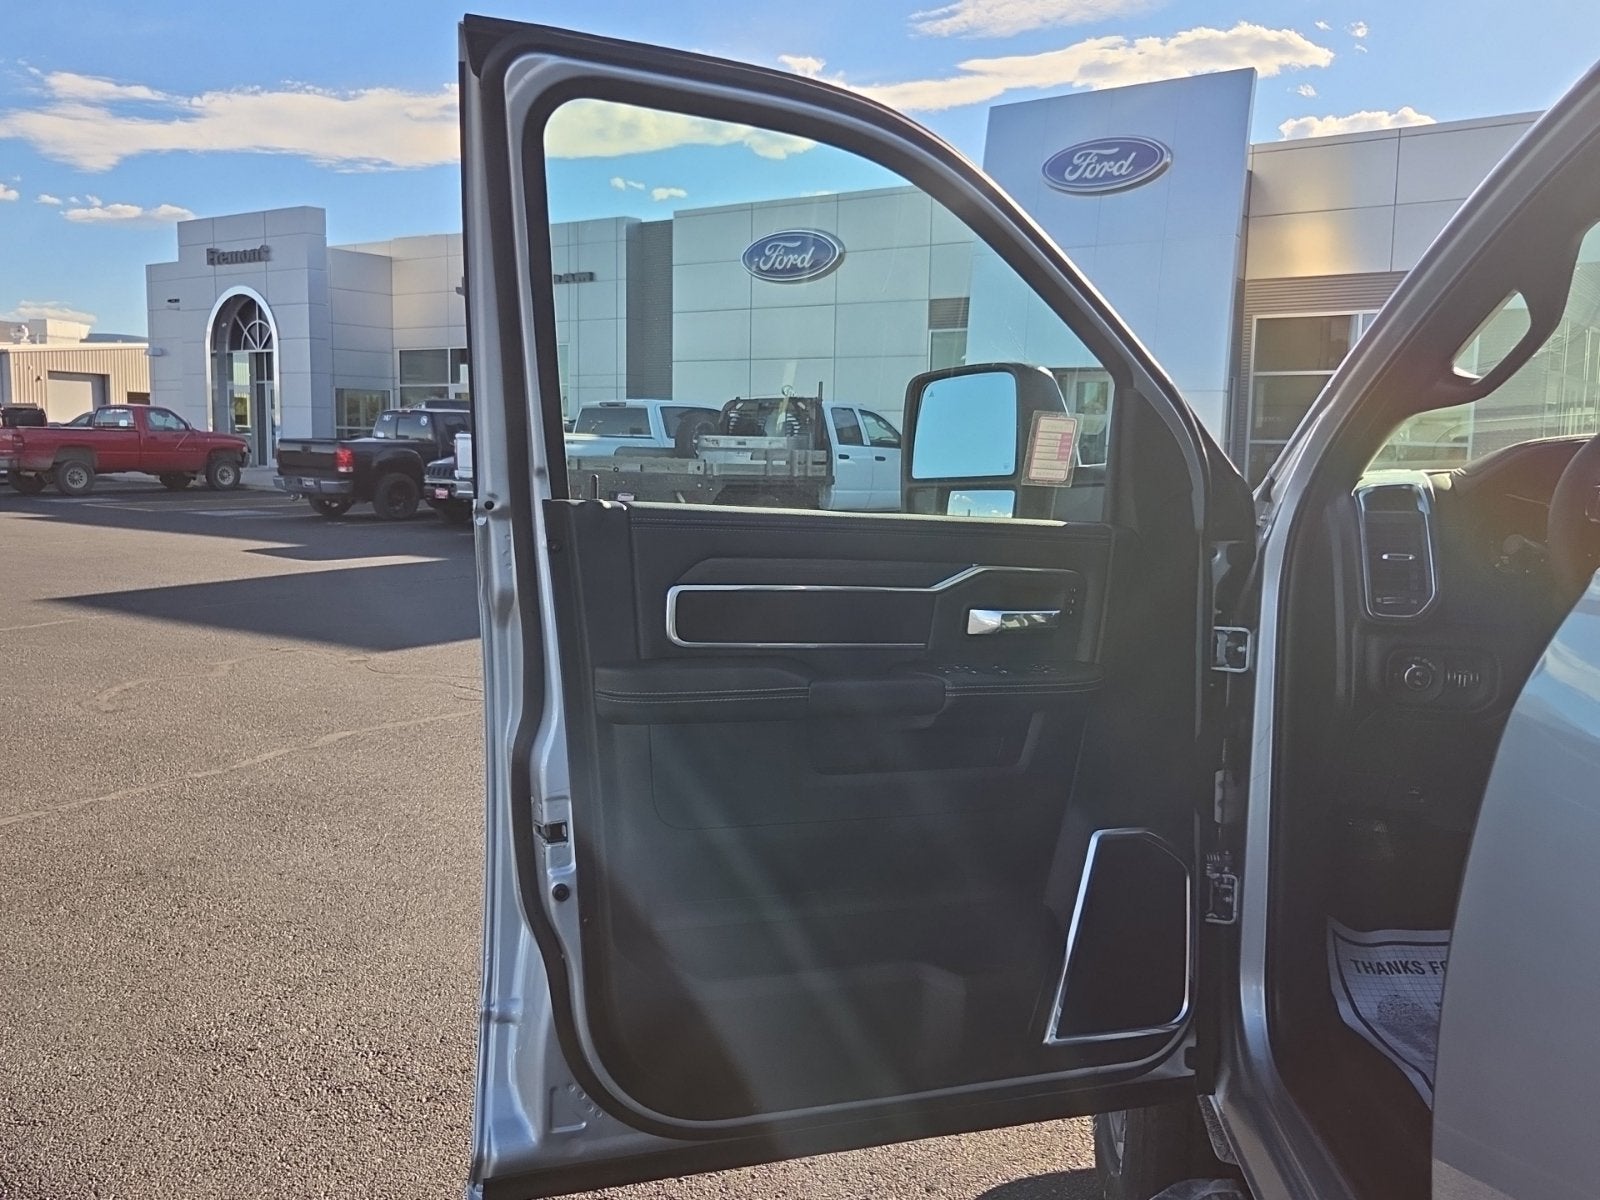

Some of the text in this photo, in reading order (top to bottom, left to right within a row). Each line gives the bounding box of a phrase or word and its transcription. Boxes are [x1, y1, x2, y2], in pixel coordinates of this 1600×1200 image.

[1064, 147, 1137, 181] Ford
[760, 241, 815, 271] Ford
[1350, 959, 1426, 975] THANKS
